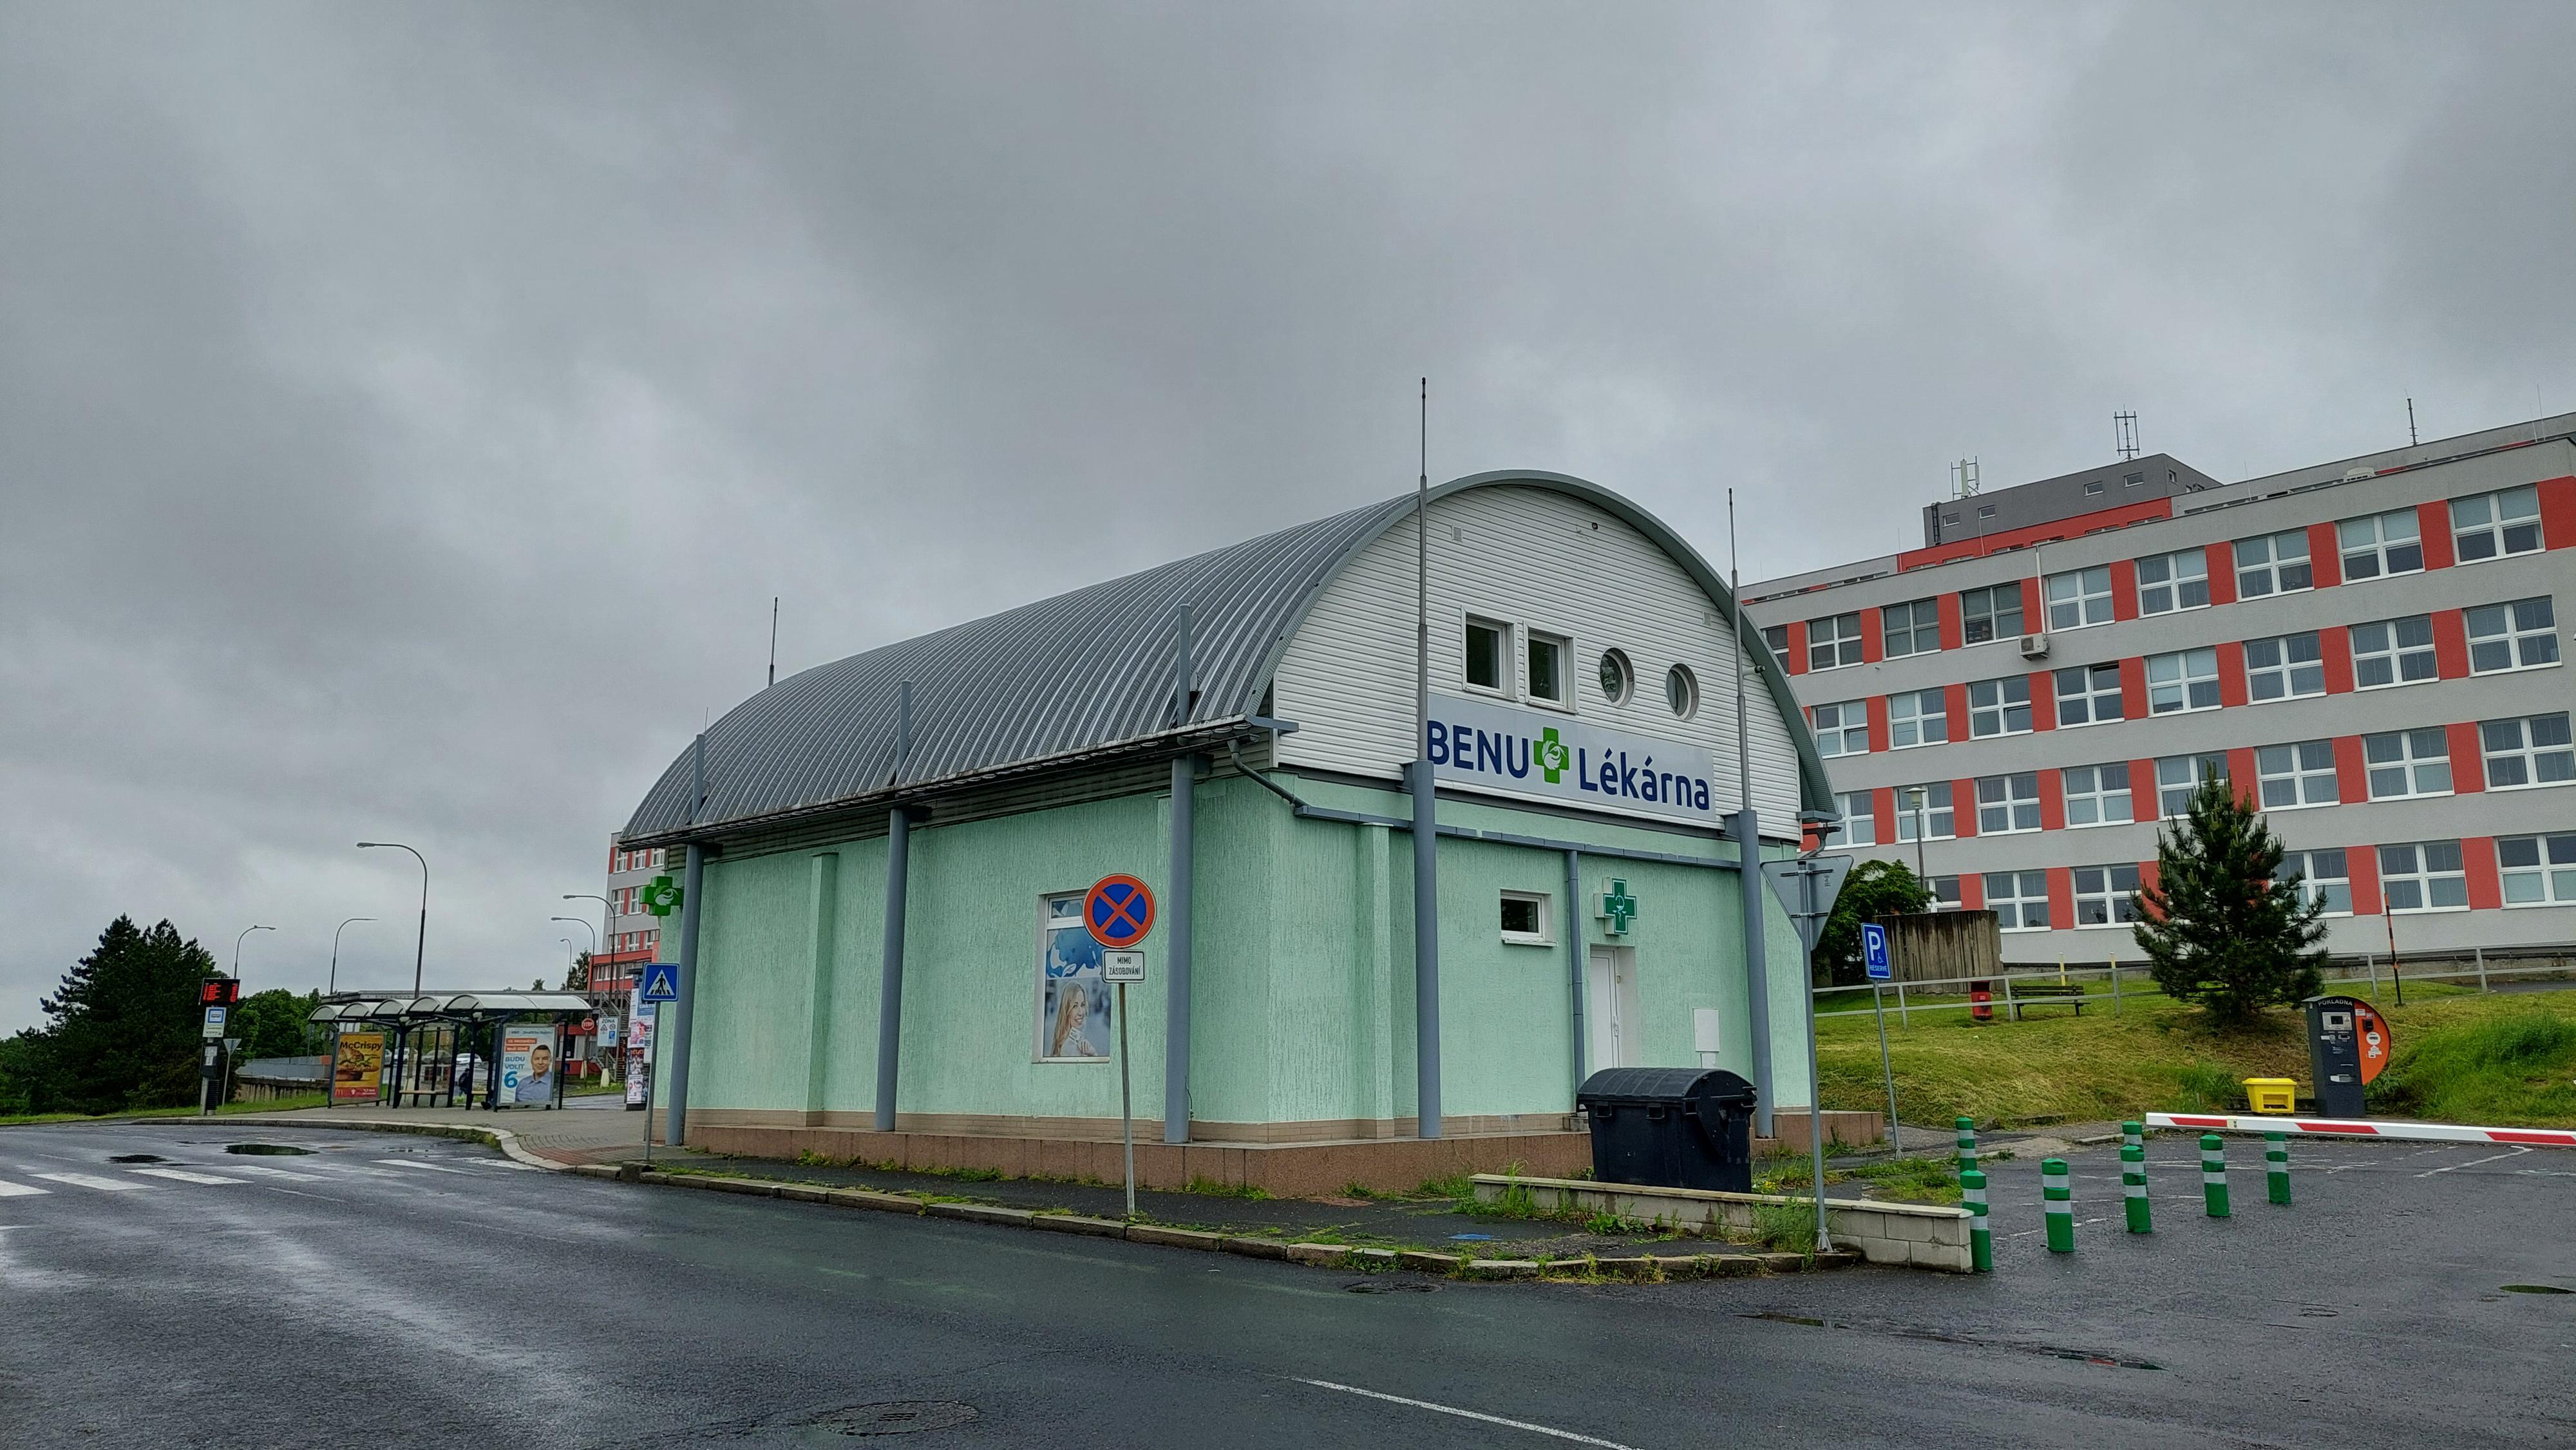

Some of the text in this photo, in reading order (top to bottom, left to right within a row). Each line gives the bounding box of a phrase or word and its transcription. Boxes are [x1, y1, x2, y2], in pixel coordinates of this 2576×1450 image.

[1427, 720, 1710, 811] BENU Lékárna
[1868, 931, 1881, 961] P
[1117, 956, 1132, 965] MIMO
[1108, 965, 1141, 975] ZÁSOBOVÁNÍ
[339, 1040, 383, 1051] McCrispy
[504, 1071, 518, 1088] 6
